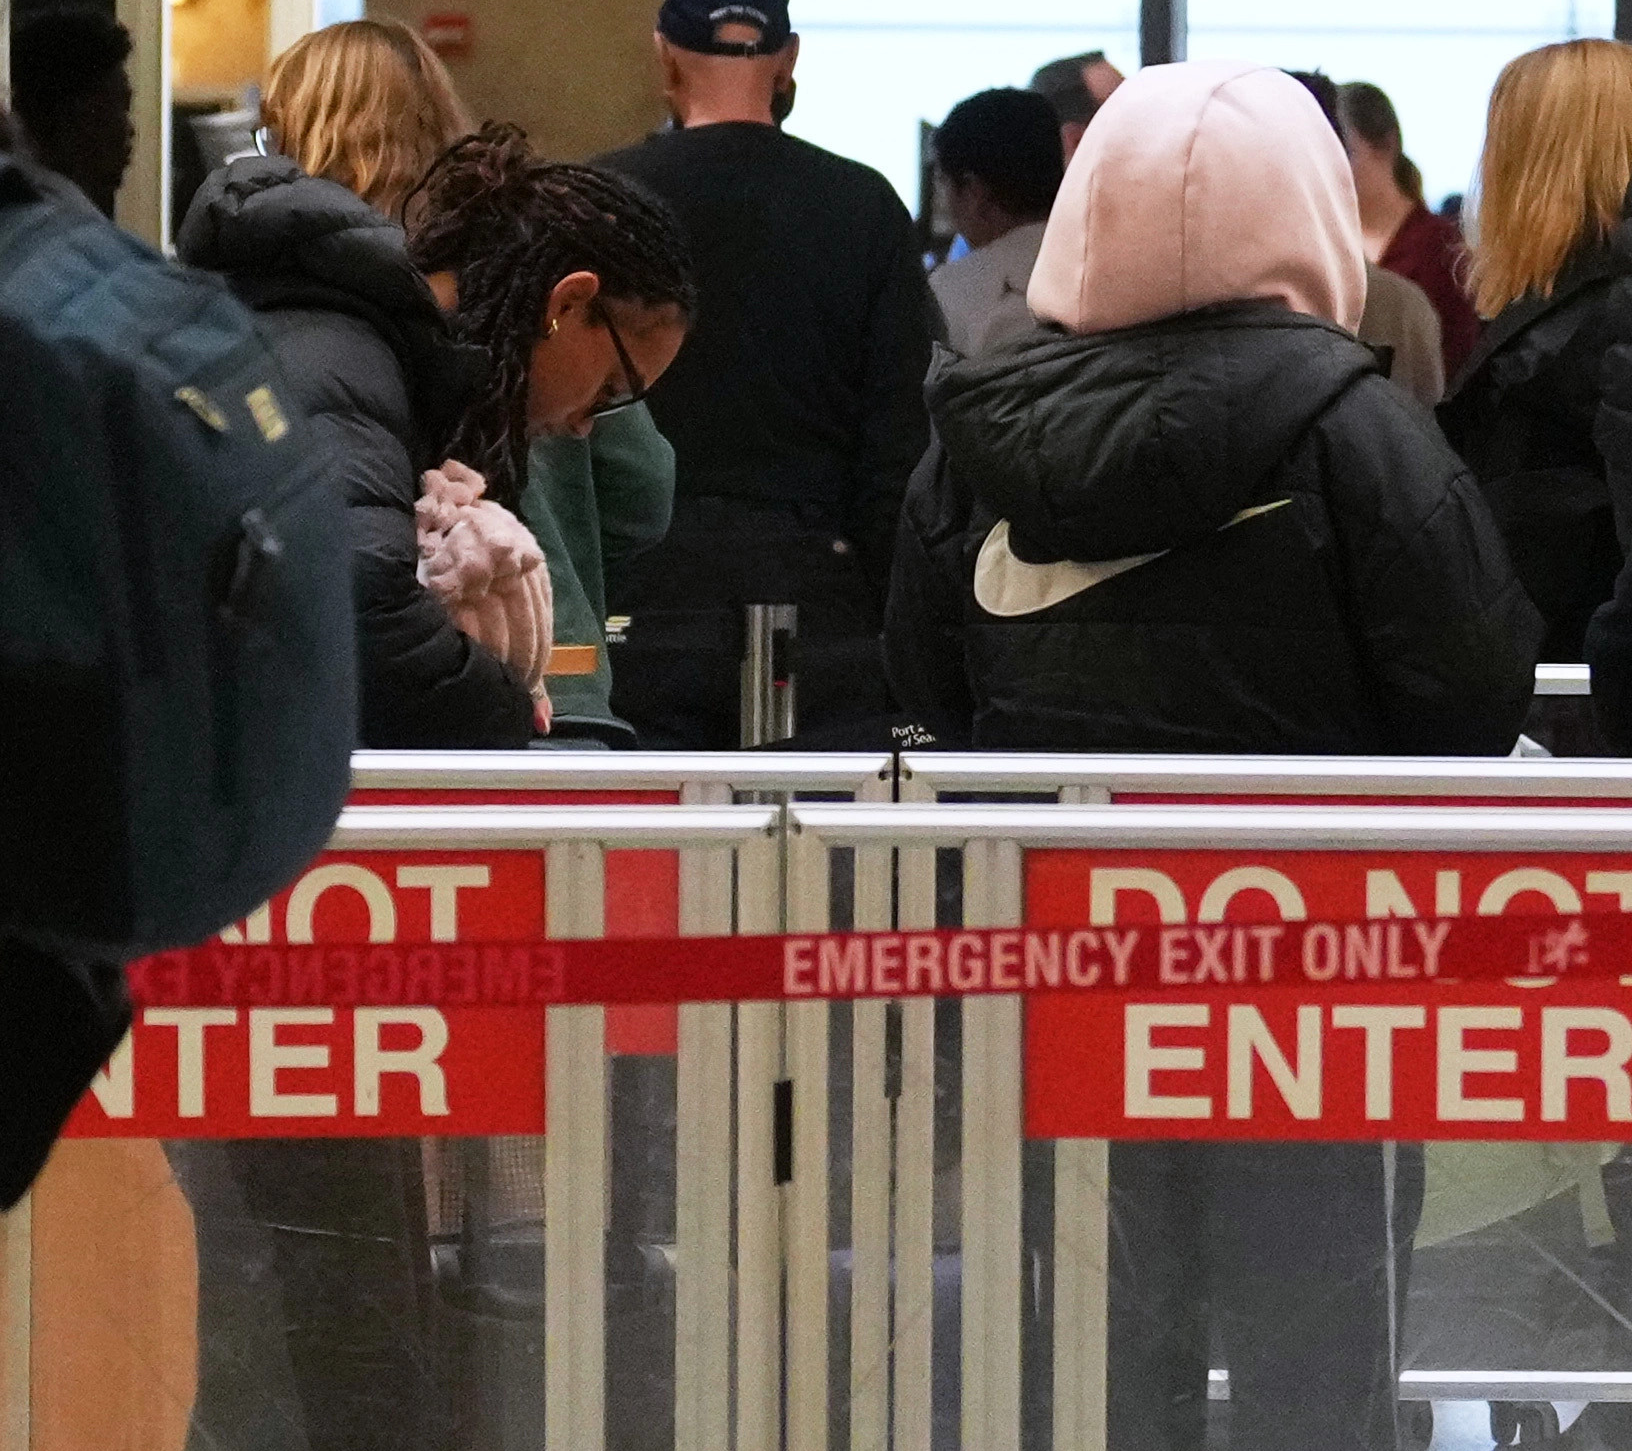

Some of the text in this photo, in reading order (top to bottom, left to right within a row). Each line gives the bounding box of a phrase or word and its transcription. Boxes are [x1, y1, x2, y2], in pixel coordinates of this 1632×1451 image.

[892, 725, 915, 738] Port
[902, 736, 912, 747] of
[221, 864, 491, 944] OT
[783, 921, 1451, 997] EMERGENCY EXIT ONLY
[90, 1006, 451, 1120] TER
